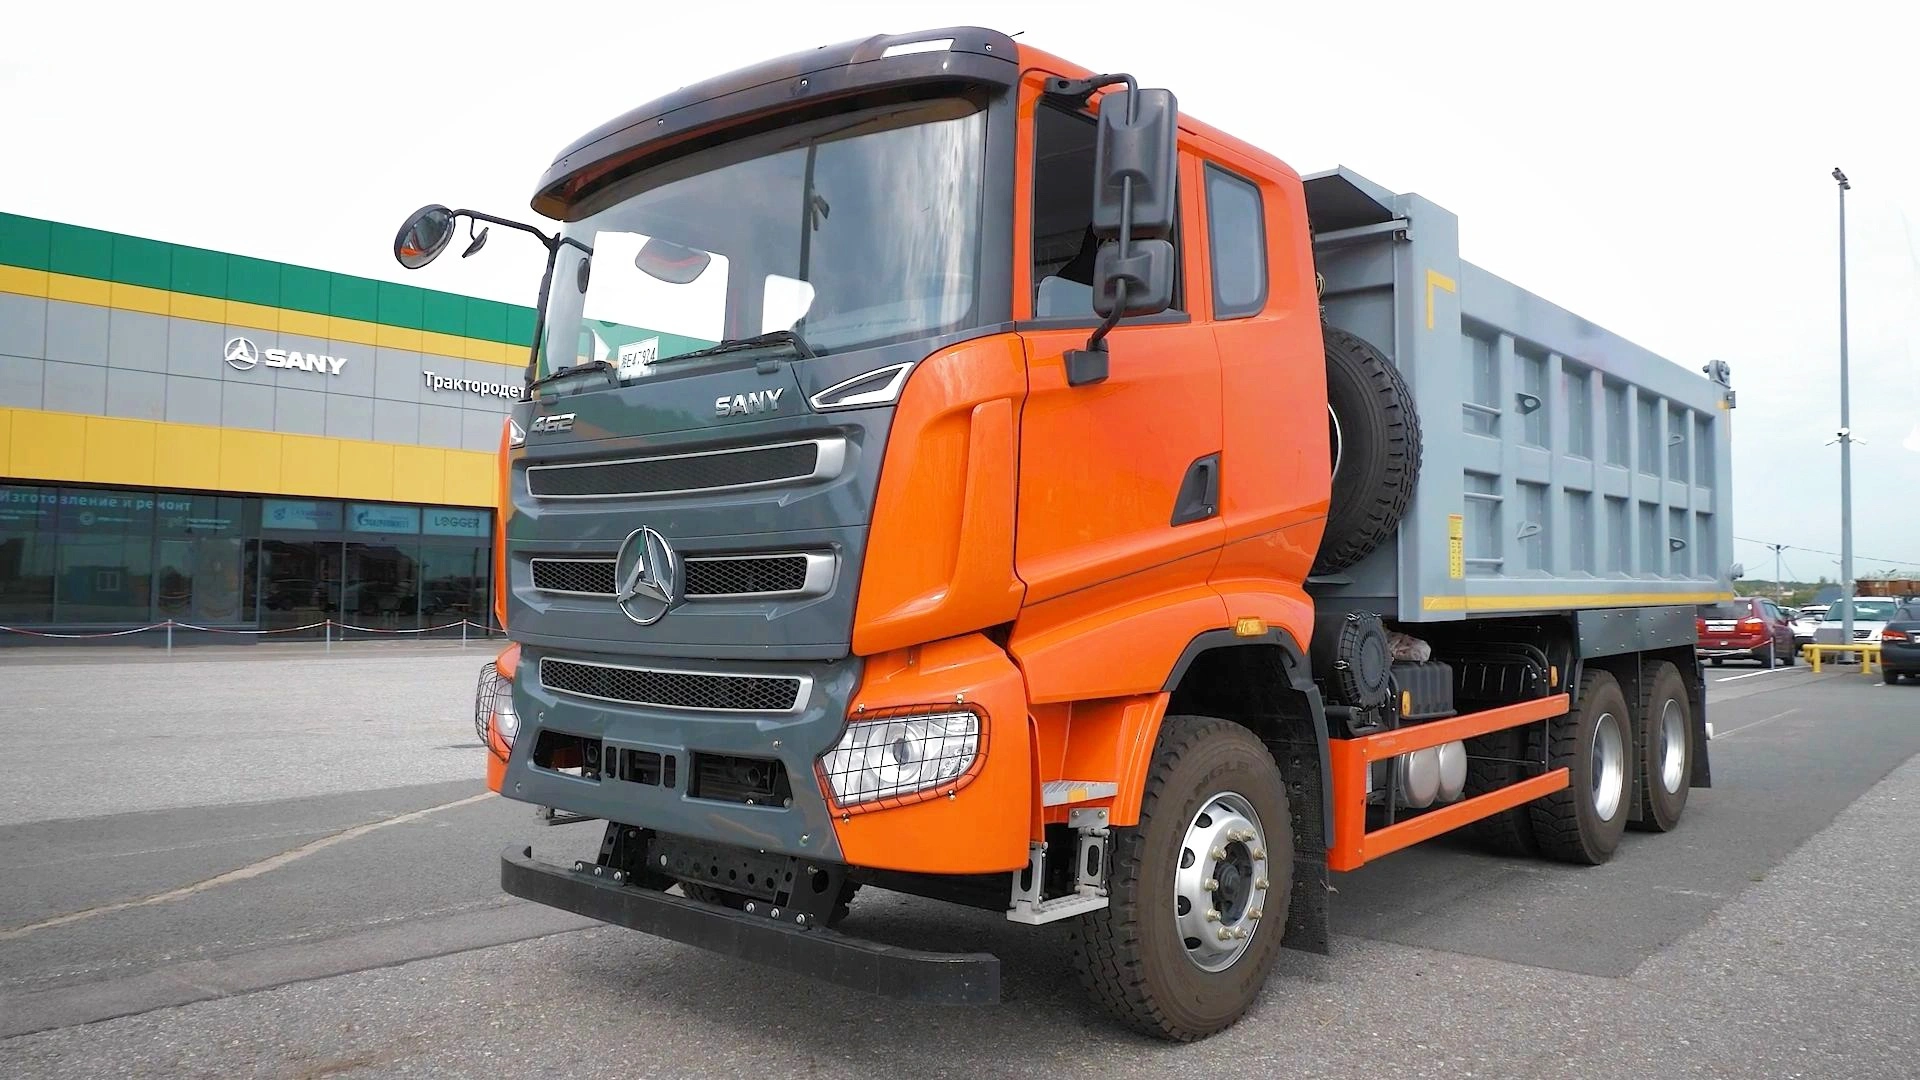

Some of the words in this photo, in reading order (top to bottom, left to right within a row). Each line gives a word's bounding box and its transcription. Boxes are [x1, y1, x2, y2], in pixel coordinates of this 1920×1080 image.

[265, 348, 348, 375] SANY
[423, 370, 534, 399] Трактородет
[715, 387, 784, 417] SANY
[434, 515, 480, 529] LOGGER
